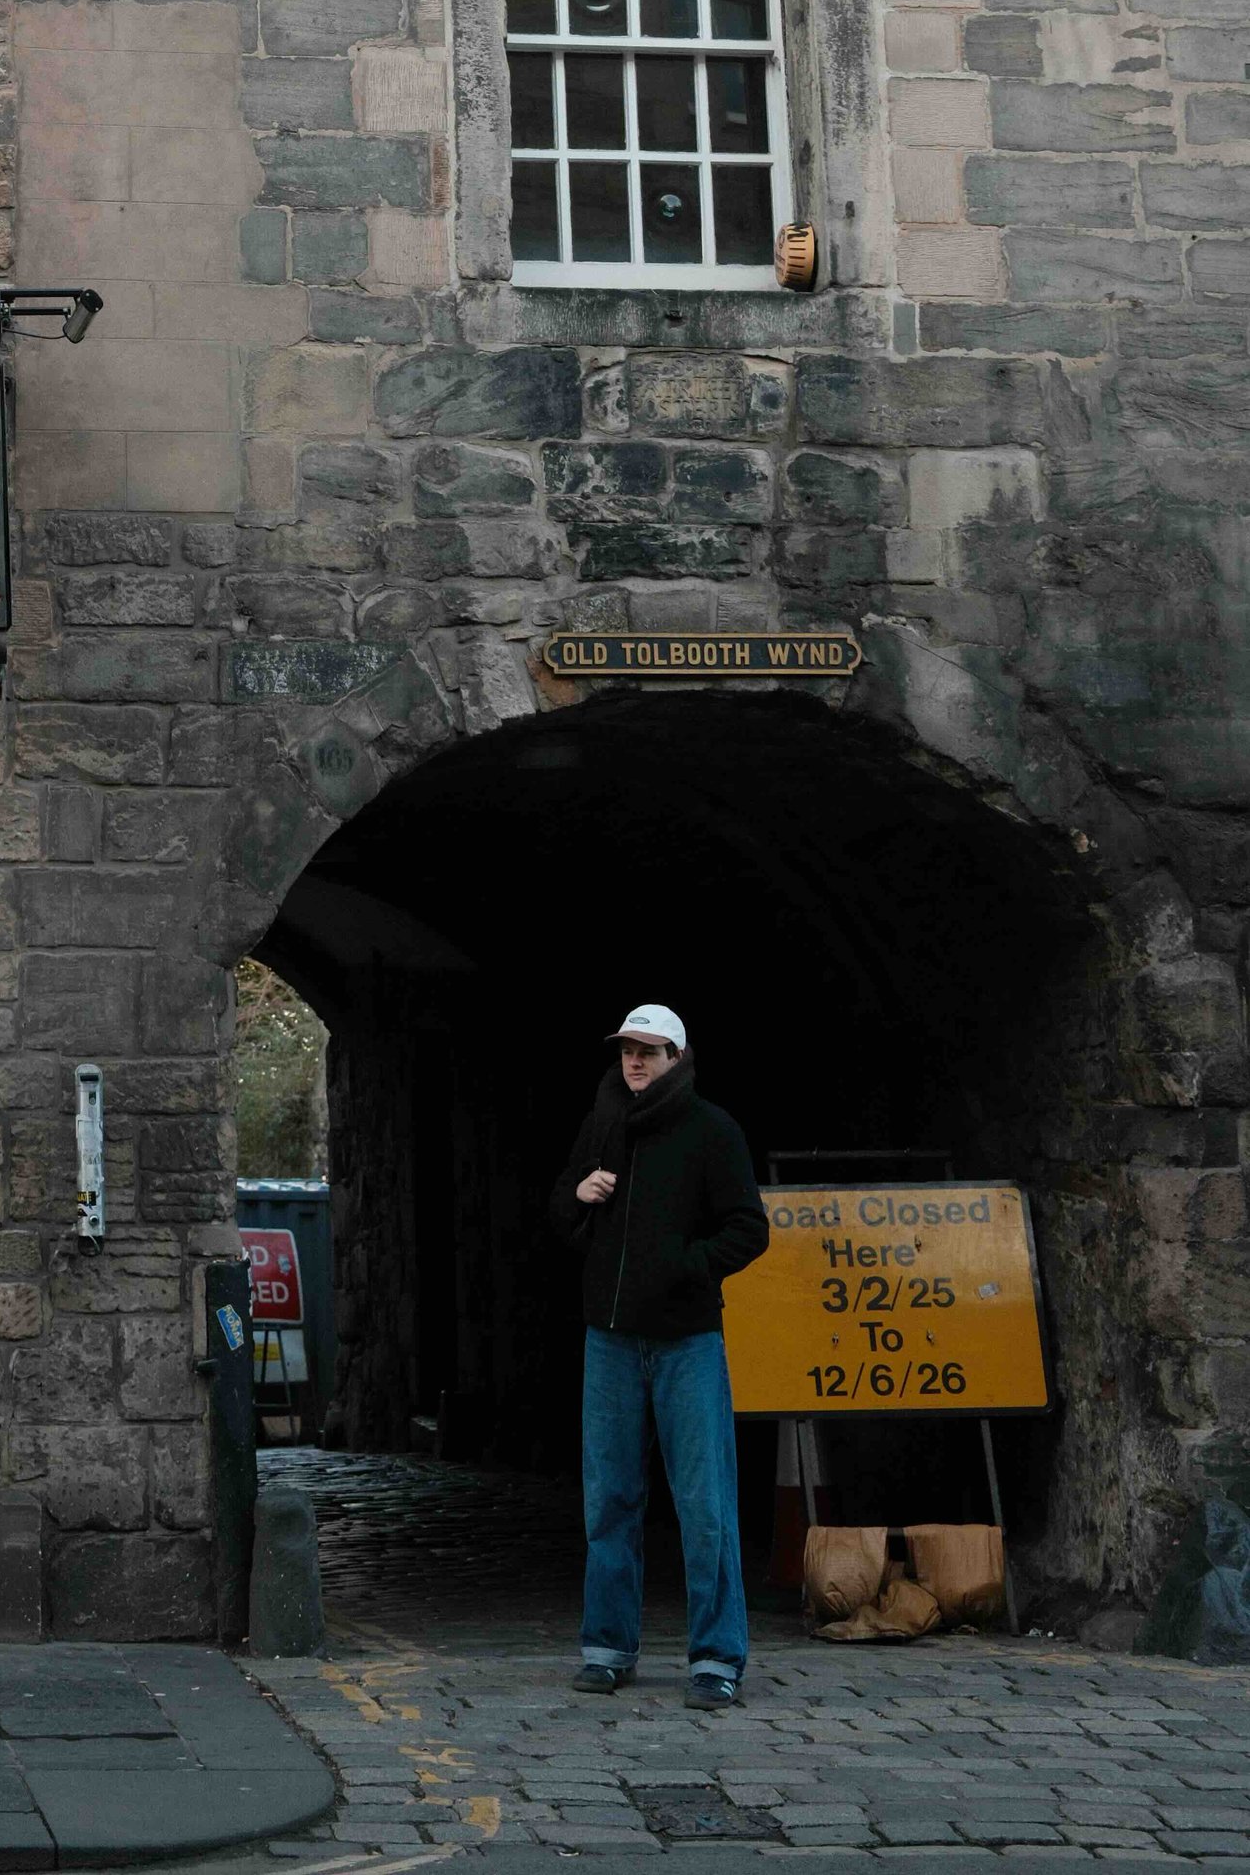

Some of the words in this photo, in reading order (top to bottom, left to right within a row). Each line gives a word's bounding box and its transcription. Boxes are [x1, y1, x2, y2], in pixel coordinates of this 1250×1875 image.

[562, 641, 608, 666] OLD
[621, 641, 750, 667] TOLBOOTH
[767, 642, 843, 667] WYND
[858, 1194, 991, 1226] Closed
[827, 1238, 916, 1268] Here
[821, 1275, 956, 1313] 3/2/25
[859, 1321, 904, 1352] To
